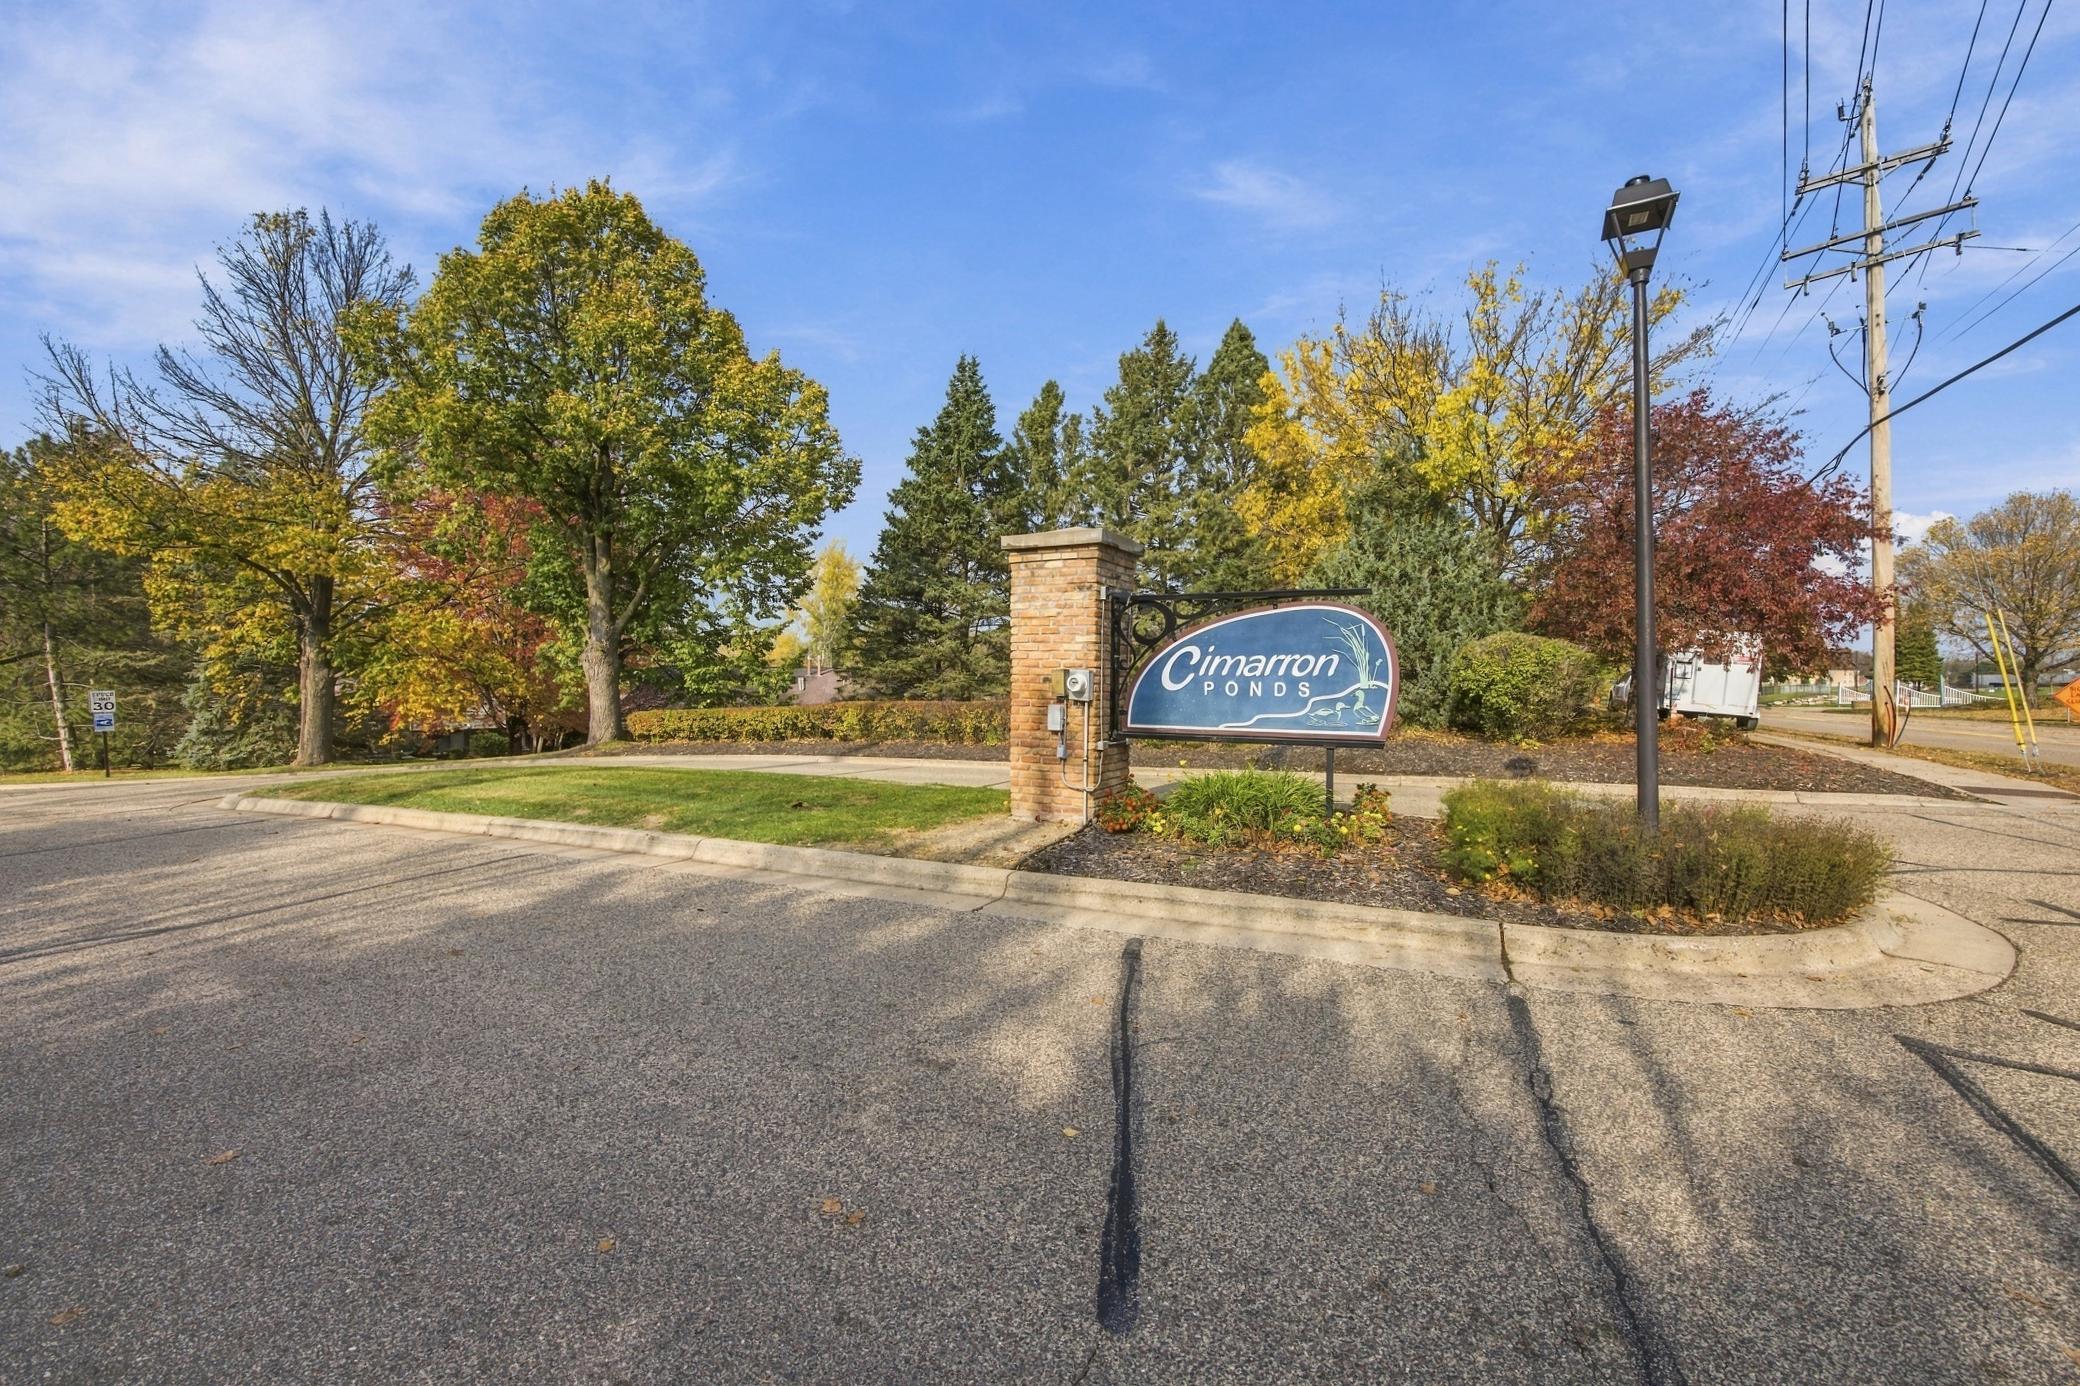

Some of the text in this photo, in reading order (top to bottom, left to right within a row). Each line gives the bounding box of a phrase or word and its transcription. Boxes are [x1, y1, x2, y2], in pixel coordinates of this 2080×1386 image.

[1161, 645, 1340, 691] Cimarron
[1204, 681, 1310, 697] PONDS
[93, 701, 114, 711] 30
